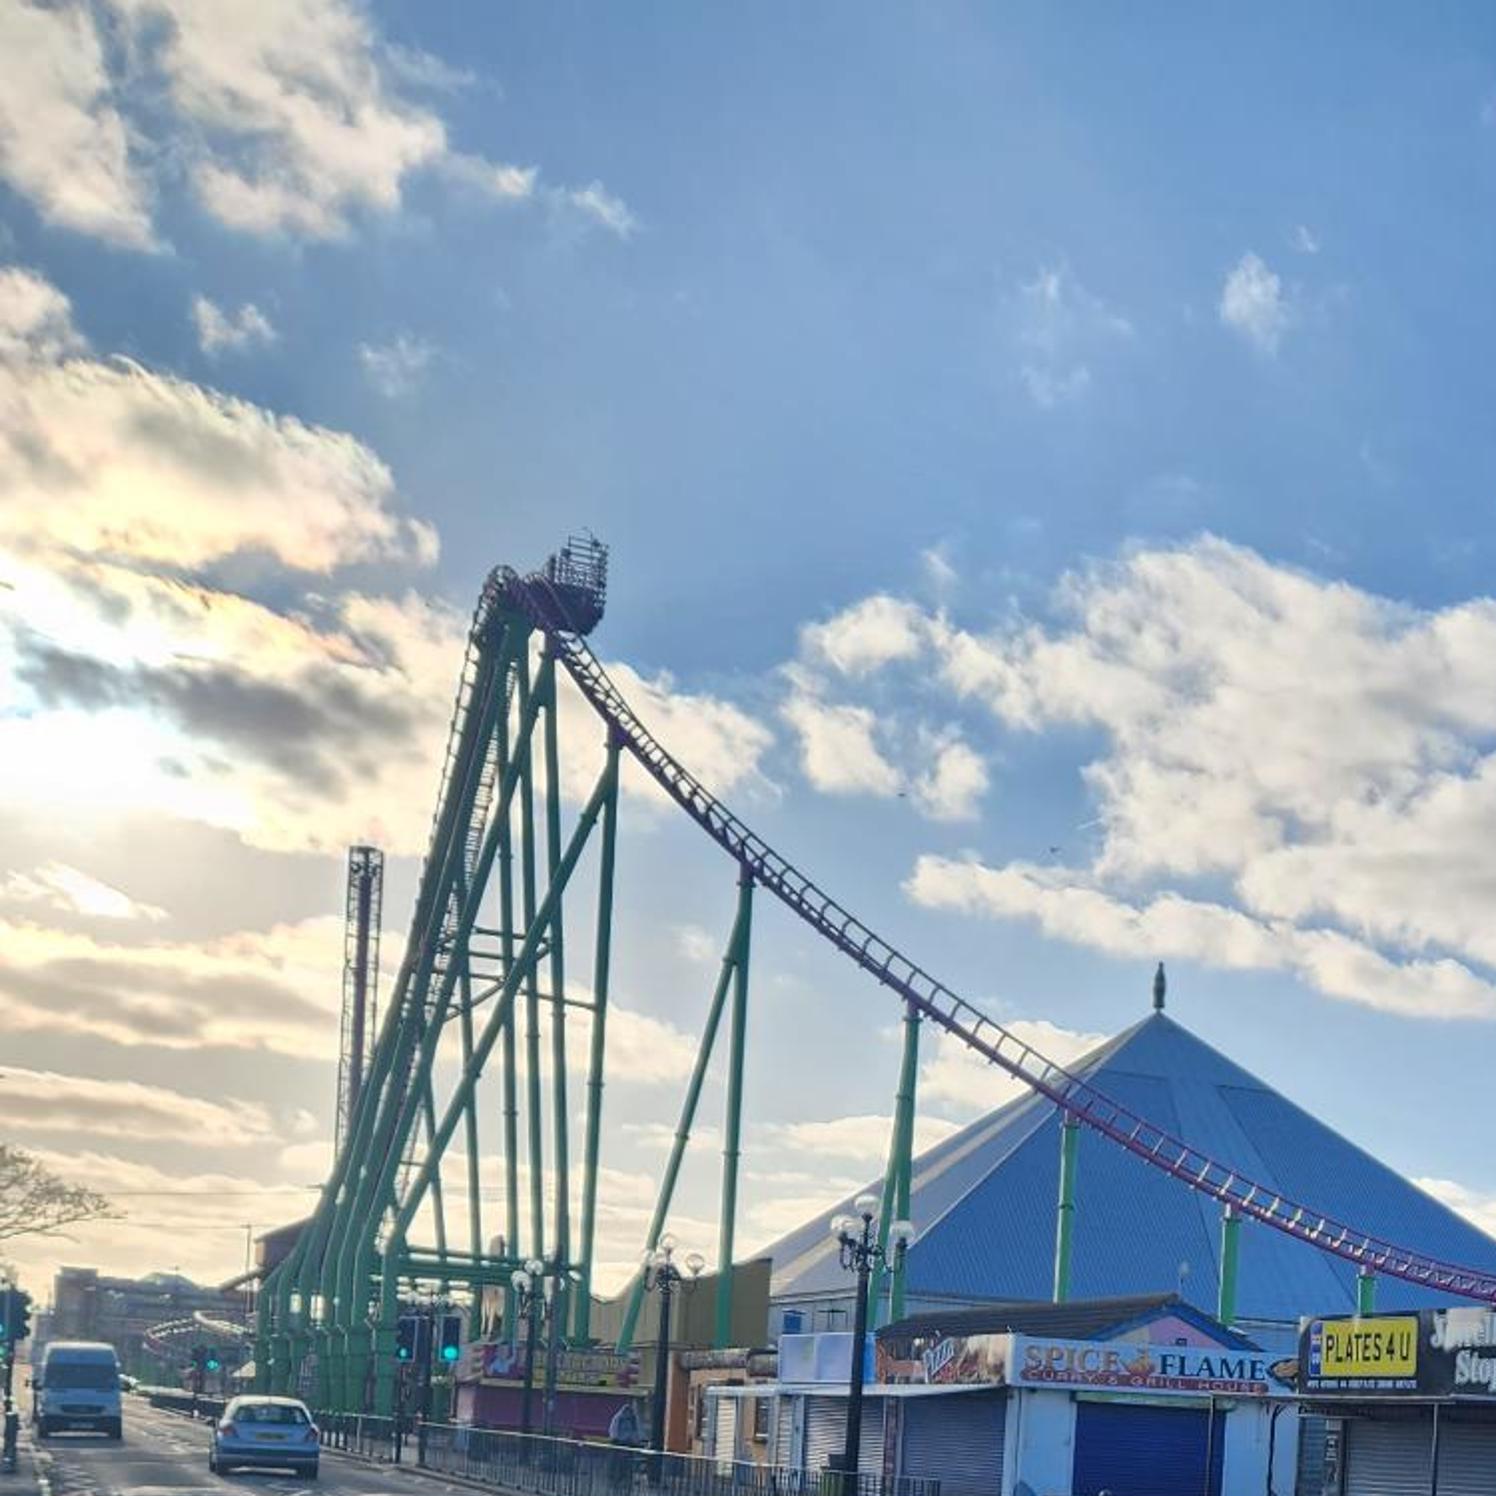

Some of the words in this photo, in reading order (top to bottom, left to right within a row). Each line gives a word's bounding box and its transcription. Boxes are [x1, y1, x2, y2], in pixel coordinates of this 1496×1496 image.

[1024, 1344, 1120, 1374] SPICE
[1160, 1353, 1266, 1381] FLAME
[1325, 1332, 1381, 1363] PLATES
[1386, 1332, 1395, 1361] 4
[1400, 1332, 1410, 1361] U
[1027, 1369, 1095, 1385] CURRY
[1130, 1376, 1187, 1389] GRILL
[1198, 1381, 1265, 1393] HOUSE
